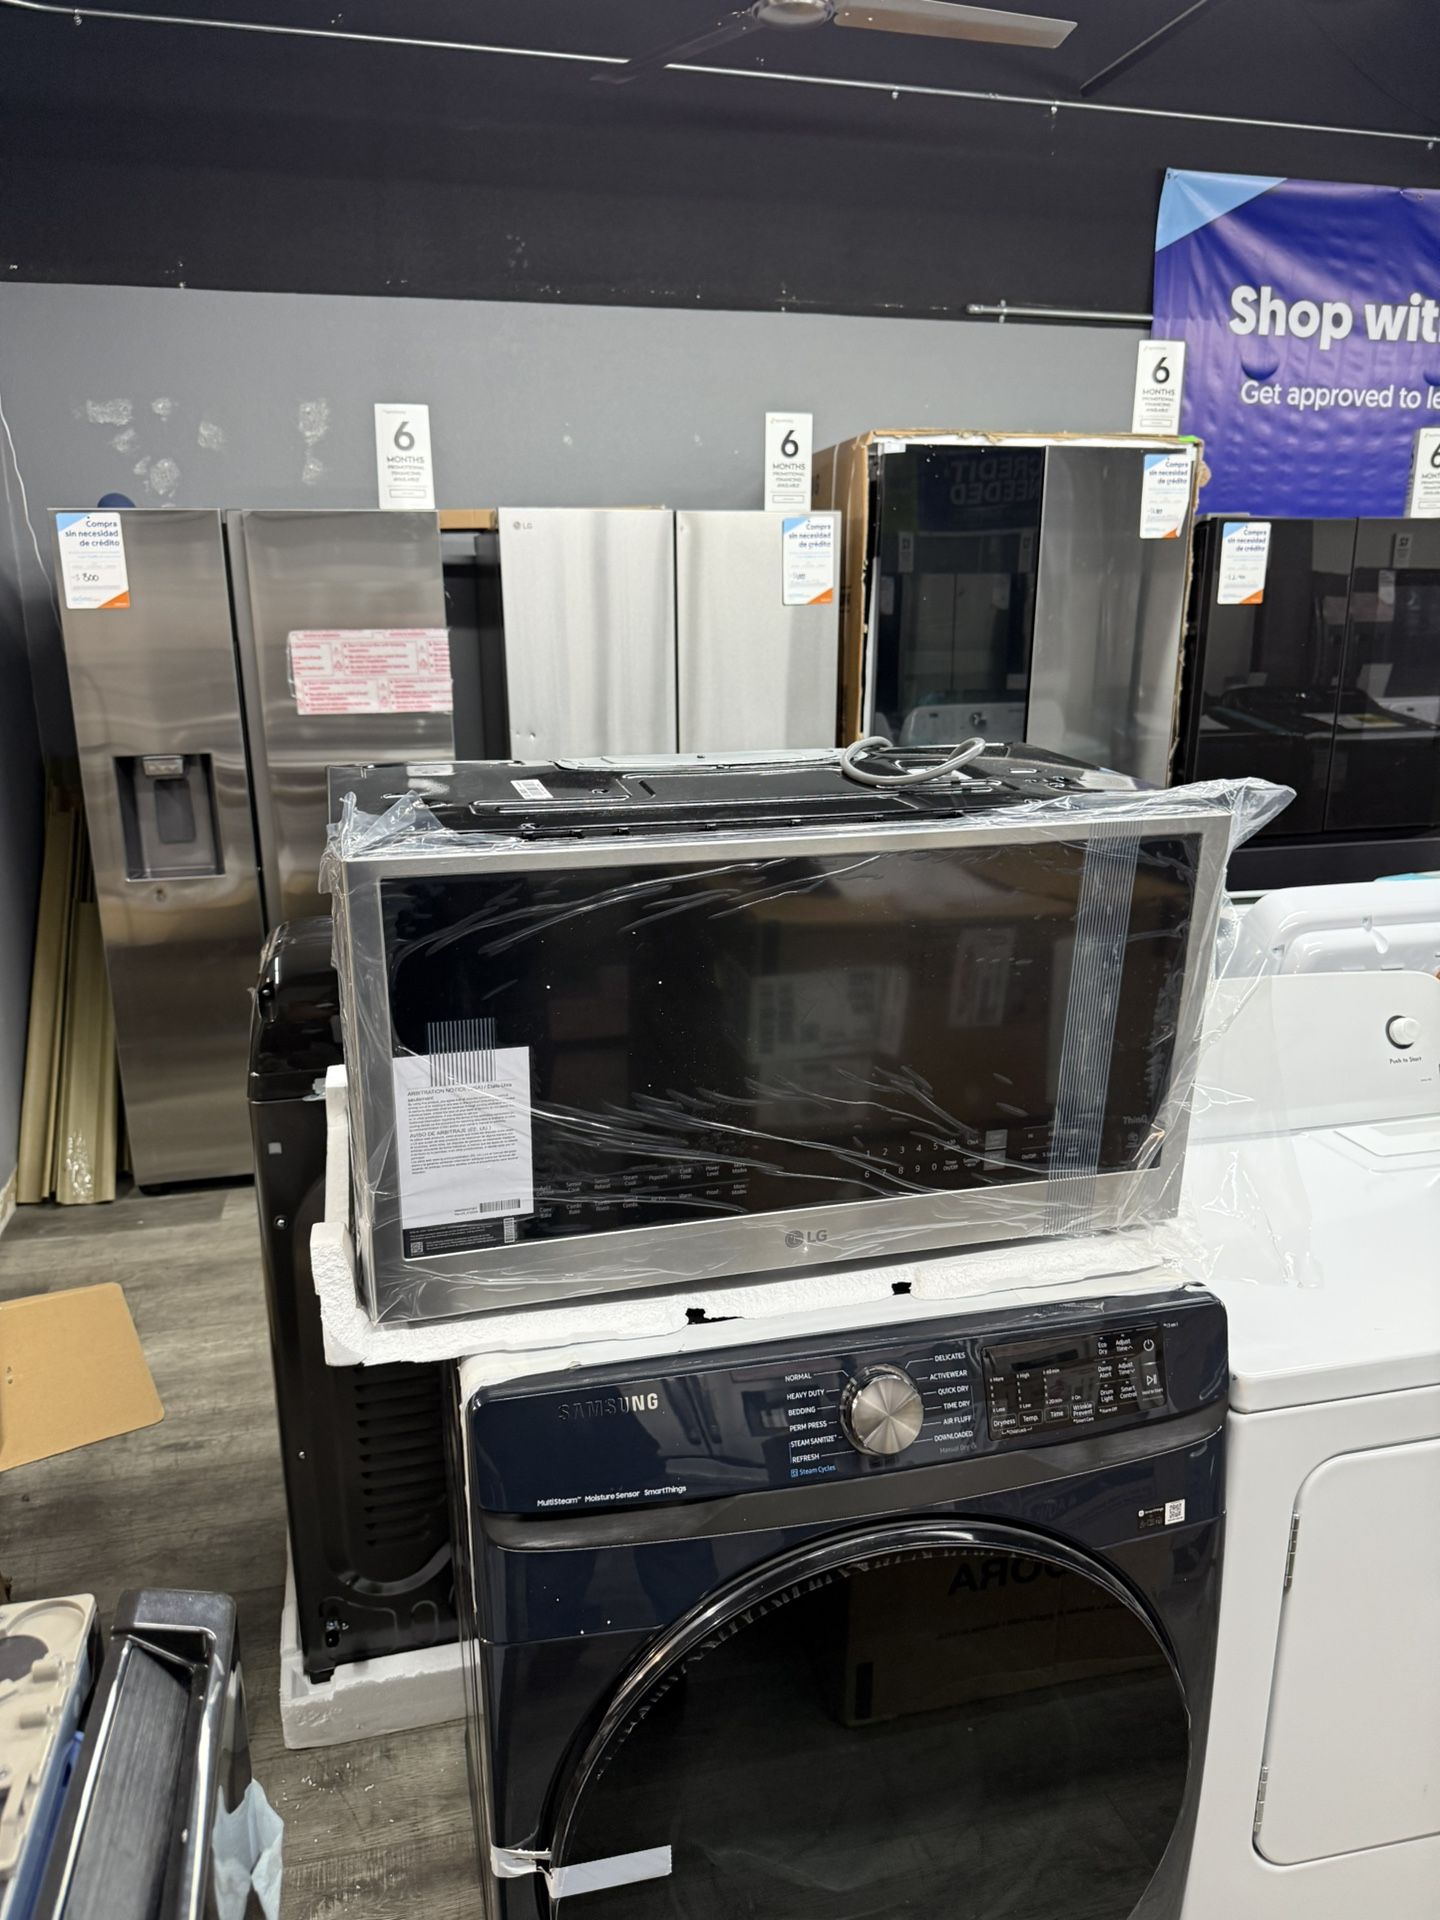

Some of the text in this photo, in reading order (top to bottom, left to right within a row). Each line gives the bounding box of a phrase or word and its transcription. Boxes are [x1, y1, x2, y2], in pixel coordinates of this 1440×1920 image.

[1229, 285, 1440, 350] Shop wit
[1152, 356, 1170, 384] 6
[1142, 388, 1175, 396] MONTHS
[1241, 380, 1282, 405] Get
[1287, 384, 1394, 411] approved
[1399, 387, 1421, 409] to
[394, 421, 415, 451] 6
[781, 430, 799, 458] 6
[386, 456, 425, 464] MONTHS
[772, 463, 806, 471] MONTHS
[1165, 461, 1189, 470] Compra
[86, 520, 118, 528] Compra
[522, 522, 533, 530] LG
[806, 524, 832, 532] Compra
[78, 530, 119, 538] necesidad
[1243, 530, 1267, 538] Compra
[409, 1130, 427, 1138] AVISO
[436, 1127, 466, 1136] ARBITRAJE
[882, 1148, 888, 1156] 2
[900, 1146, 904, 1154] 3
[916, 1144, 922, 1152] 4
[932, 1142, 938, 1150] 5
[864, 1170, 870, 1178] 6
[898, 1166, 904, 1174] 8
[915, 1164, 920, 1172] 9
[932, 1163, 937, 1171] 0
[807, 1229, 828, 1242] LG
[1116, 1338, 1131, 1346] Adjust
[934, 1352, 966, 1362] DELICATES
[785, 1373, 812, 1382] NORMAL
[930, 1370, 968, 1380] ACTIVEWEAR
[1020, 1372, 1030, 1380] High
[786, 1389, 825, 1400] HEAVY DUTY
[938, 1385, 969, 1396] QUICK DRY
[558, 1392, 659, 1420] SAMSUNG
[944, 1400, 970, 1410] TIME DRY
[1072, 1402, 1093, 1410] Wrinkle
[788, 1406, 816, 1416] BEDDING
[943, 1415, 972, 1425] AIR FLUFF
[994, 1418, 1016, 1428] Dryness
[1022, 1415, 1039, 1423] Temp.
[790, 1420, 828, 1432] PERM PRESS
[934, 1430, 974, 1442] DOWNLOADED
[790, 1439, 810, 1448] STEAM
[792, 1453, 820, 1464] REFRESH
[799, 1464, 836, 1476] Steam Cycles
[584, 1494, 614, 1502] Moisture
[616, 1490, 640, 1500] Sensor
[644, 1486, 686, 1496] SmartThings
